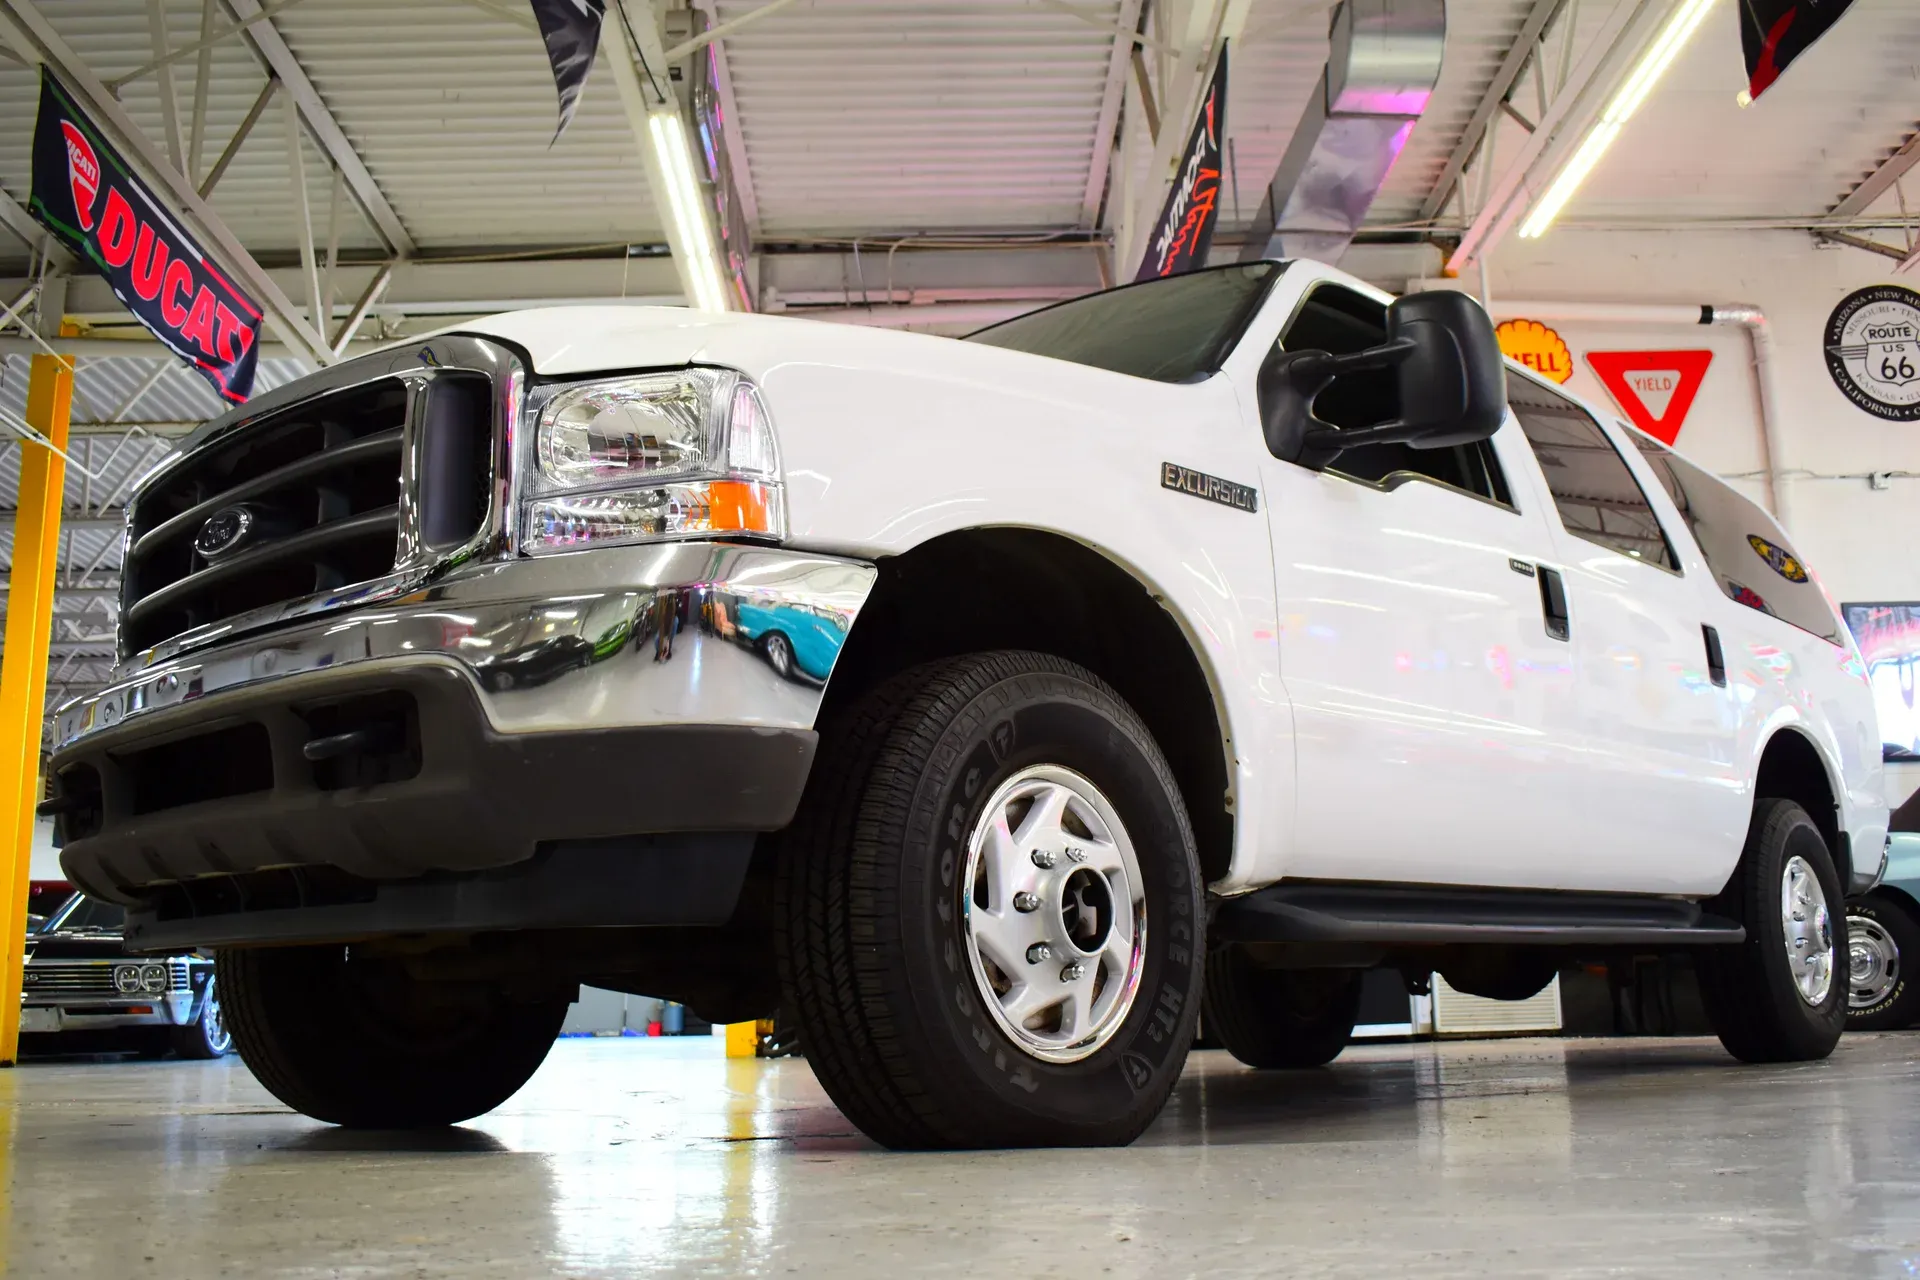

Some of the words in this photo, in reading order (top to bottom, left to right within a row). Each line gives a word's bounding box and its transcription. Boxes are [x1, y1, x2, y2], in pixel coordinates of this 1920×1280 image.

[65, 137, 96, 182] UCATI
[97, 185, 255, 365] DUCATI
[1834, 295, 1867, 336] ARIZONA
[1875, 291, 1902, 300] NEW
[1846, 306, 1890, 336] MISSOURI
[1868, 327, 1911, 339] ROUTE
[1513, 352, 1561, 372] ELL
[1882, 344, 1905, 353] US
[1881, 356, 1915, 380] 66
[1634, 377, 1672, 392] YIELD
[1835, 368, 1901, 417] CALIFORNIA
[1856, 373, 1897, 401] KANSAS
[1164, 463, 1258, 511] EXCURSION
